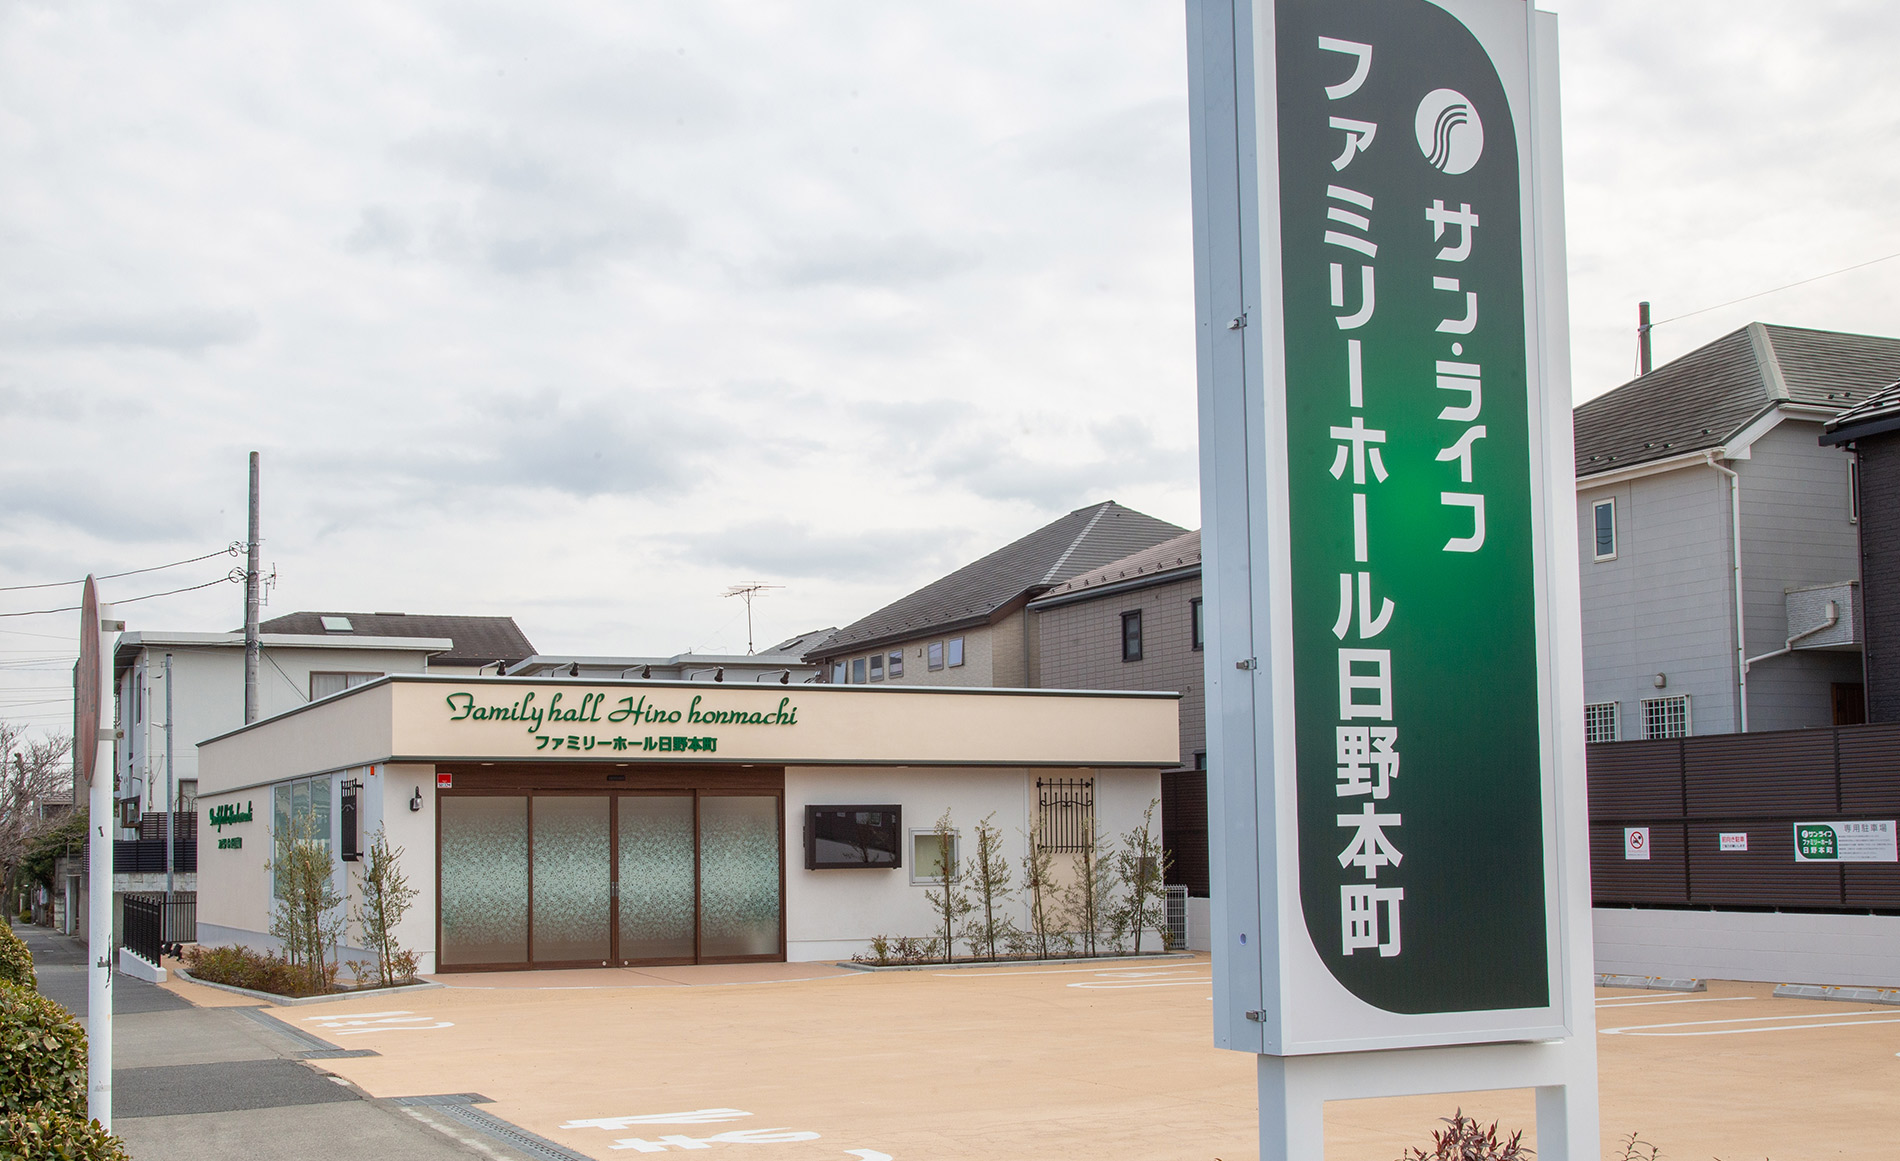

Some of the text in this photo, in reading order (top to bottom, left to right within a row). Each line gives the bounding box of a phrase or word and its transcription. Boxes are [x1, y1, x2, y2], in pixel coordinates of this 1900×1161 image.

[1319, 36, 1404, 957] ファミリーホール日野本町
[446, 691, 799, 733] Family hall Hino honmachi
[535, 735, 717, 752] ファミリーホール日野本町
